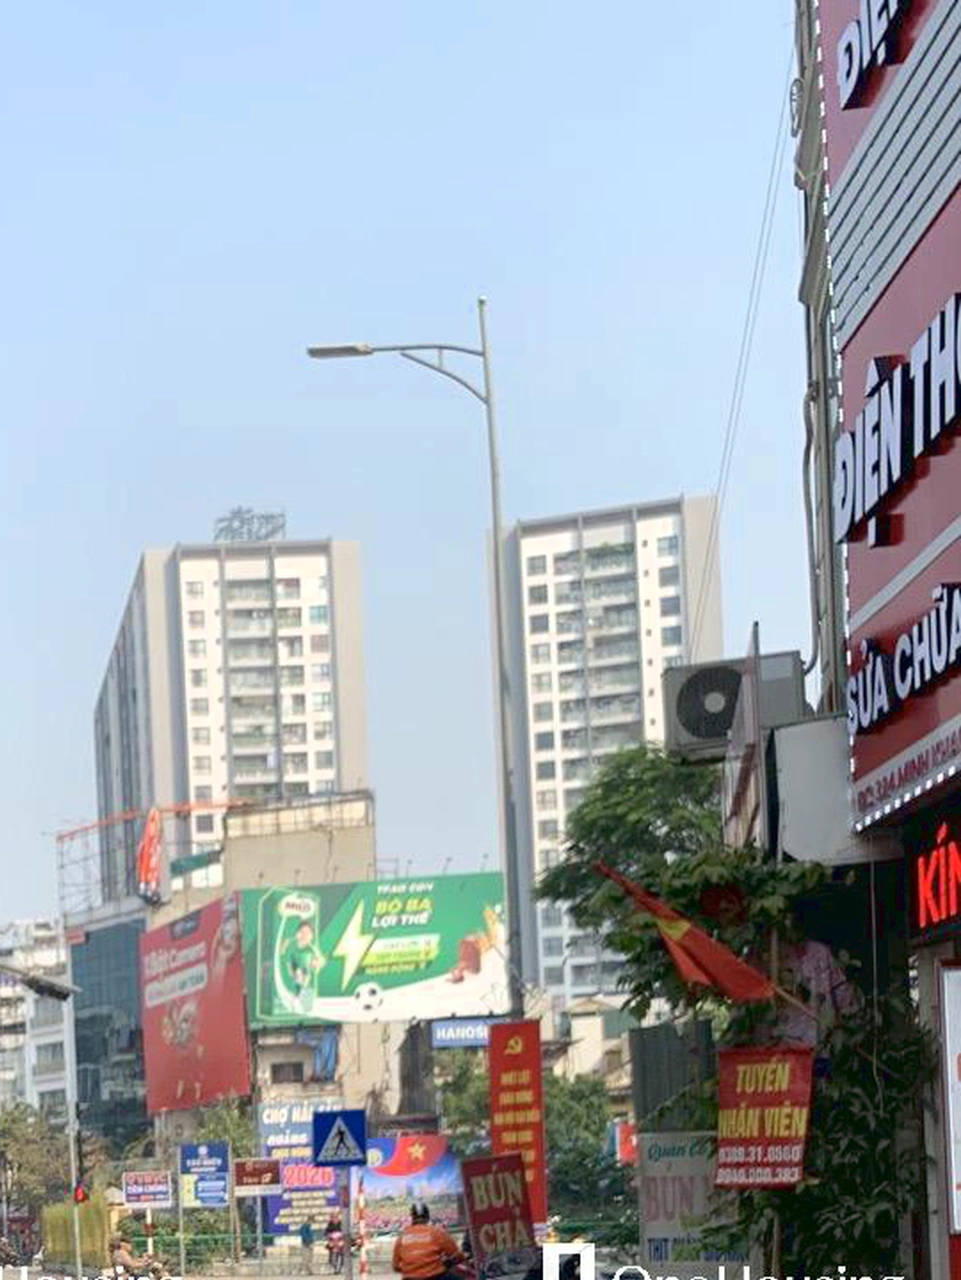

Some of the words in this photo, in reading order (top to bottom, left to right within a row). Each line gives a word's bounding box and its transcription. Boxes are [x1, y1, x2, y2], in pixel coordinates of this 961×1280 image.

[833, 358, 902, 548] ĐIỆN
[909, 294, 961, 458] TH
[846, 639, 889, 736] SỬA
[764, 1100, 808, 1138] VIÊN
[469, 1163, 524, 1212] BÚN
[479, 1205, 532, 1252] CHẢ
